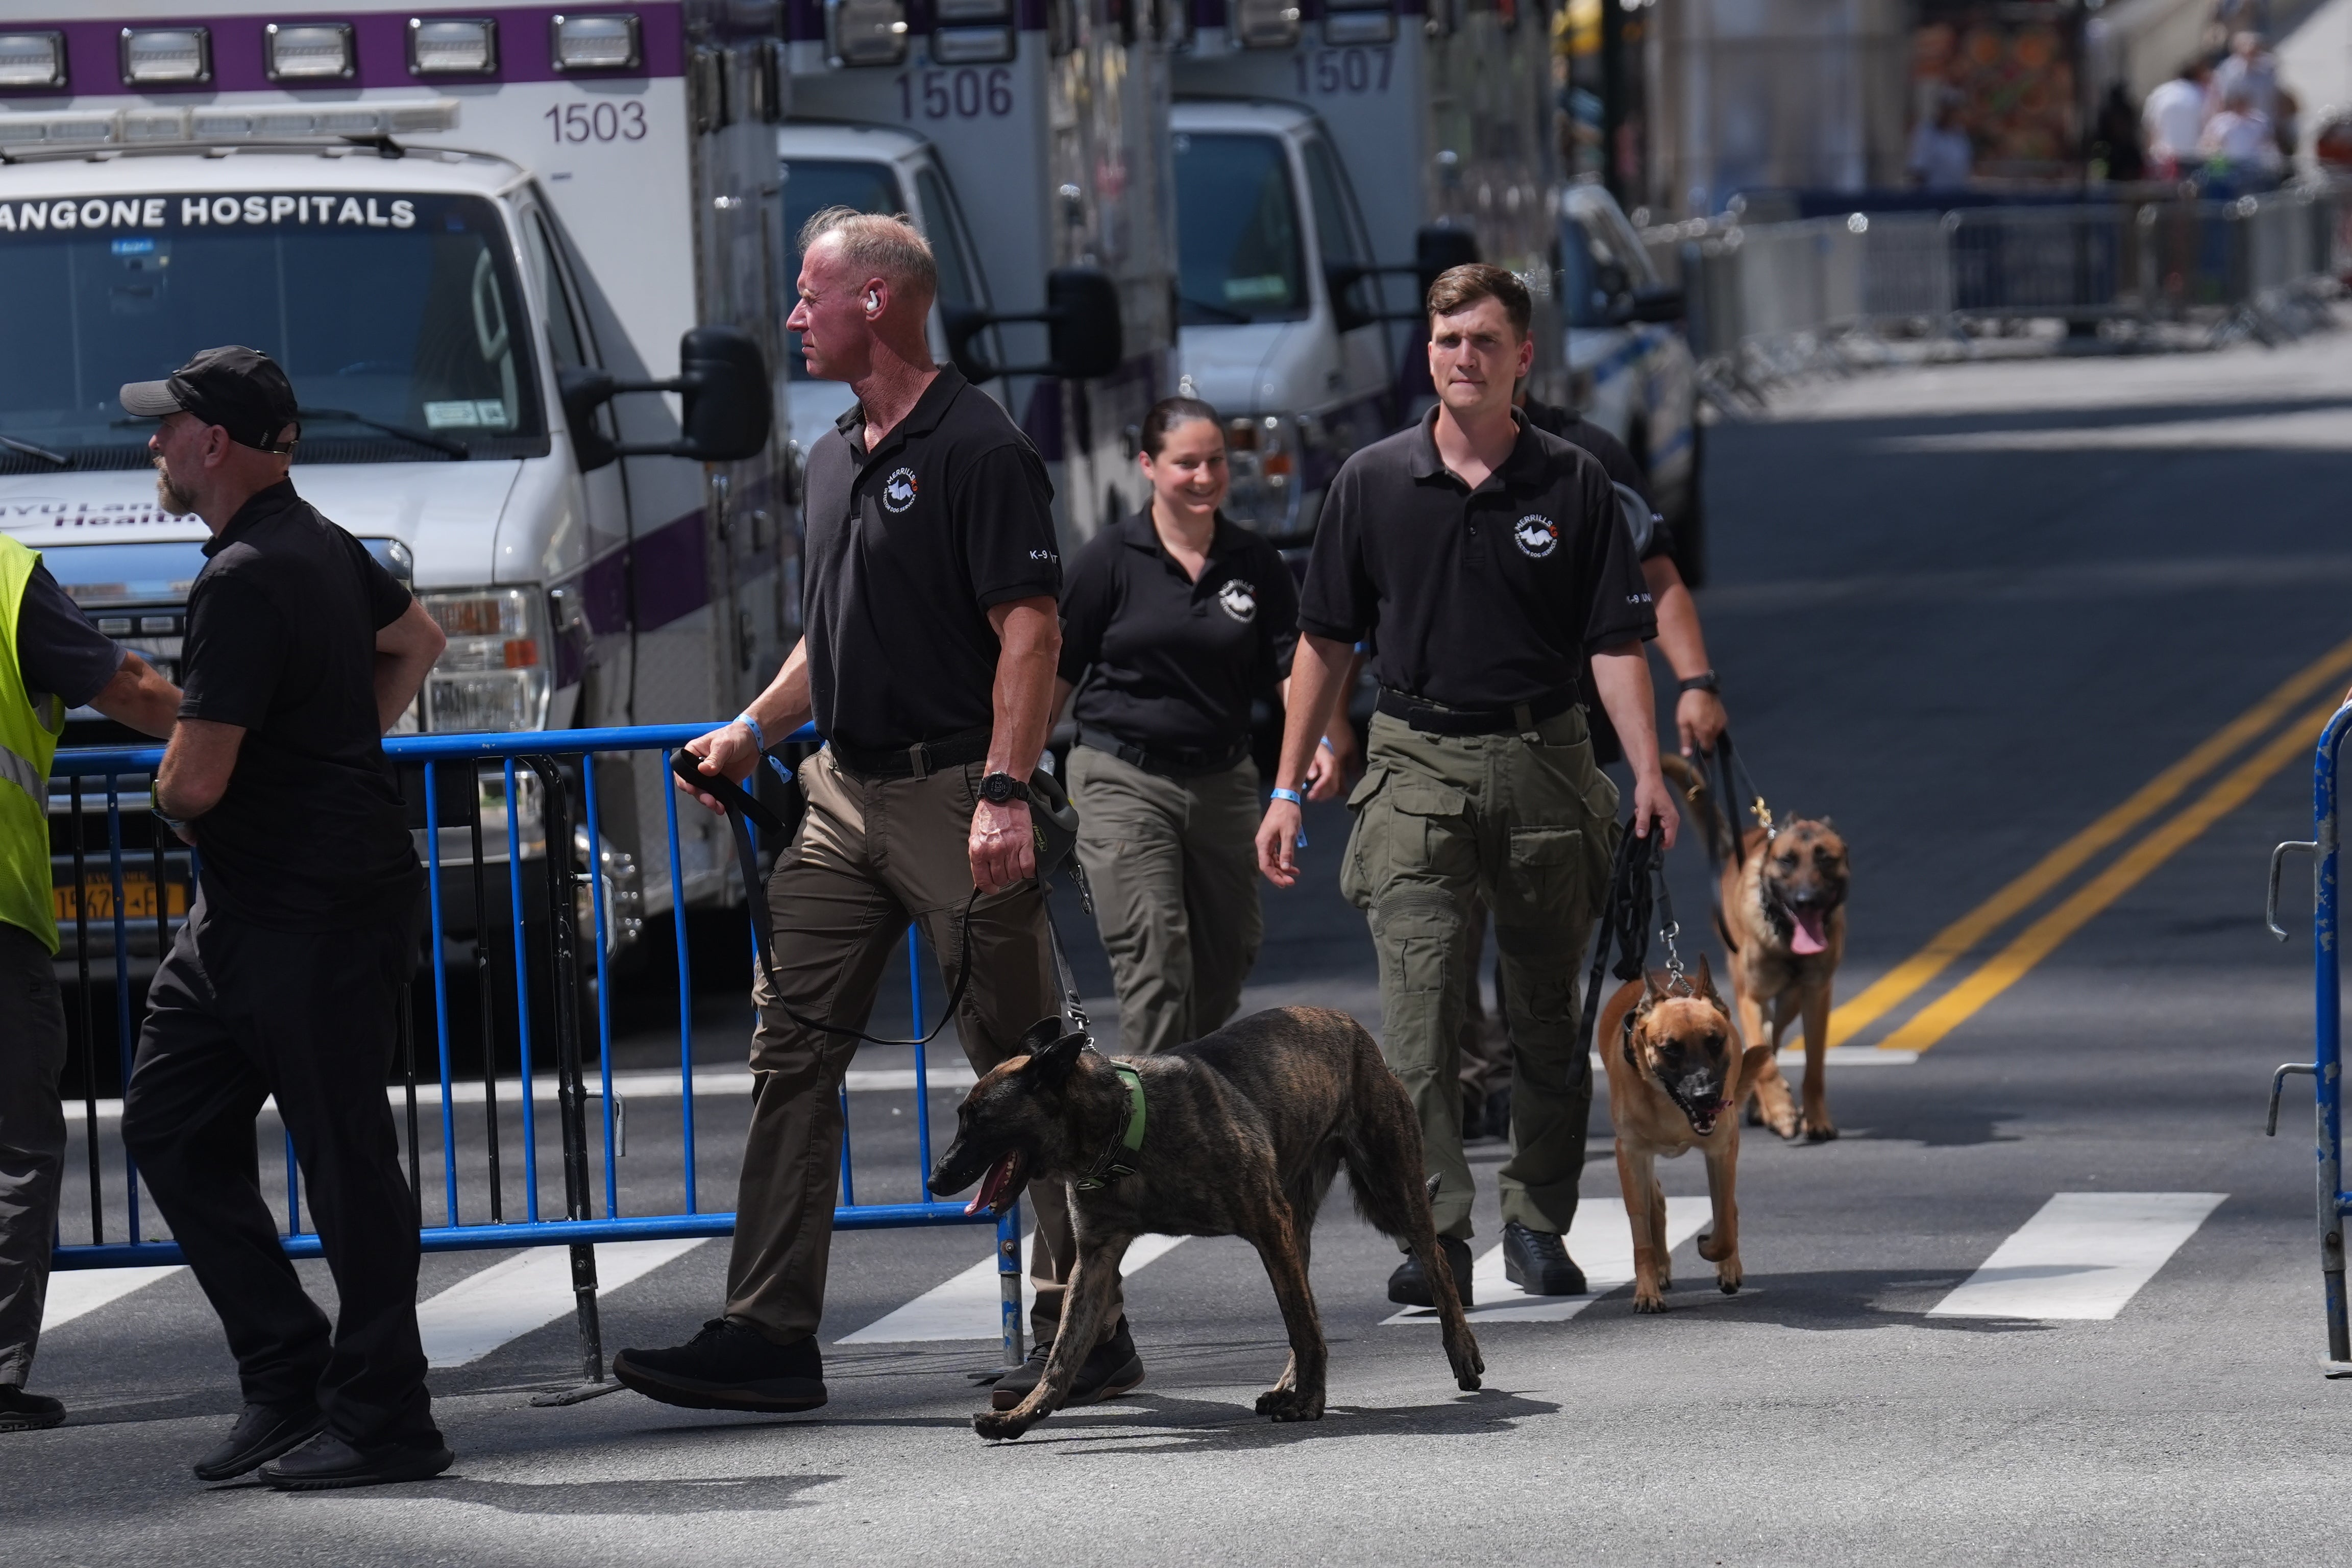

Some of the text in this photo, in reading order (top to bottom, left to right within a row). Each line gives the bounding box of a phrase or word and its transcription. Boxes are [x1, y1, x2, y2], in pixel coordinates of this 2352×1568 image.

[1292, 47, 1394, 93] 1507
[895, 67, 1013, 120] 1506
[544, 101, 647, 144] 1503
[182, 195, 416, 228] HOSPITALS
[79, 503, 153, 512] Lan
[883, 488, 891, 510] DETECTOR
[900, 494, 916, 512] SERVICES
[1030, 550, 1047, 559] K-9
[1515, 533, 1531, 555] DETECTOR
[1541, 538, 1557, 556] SERVICES
